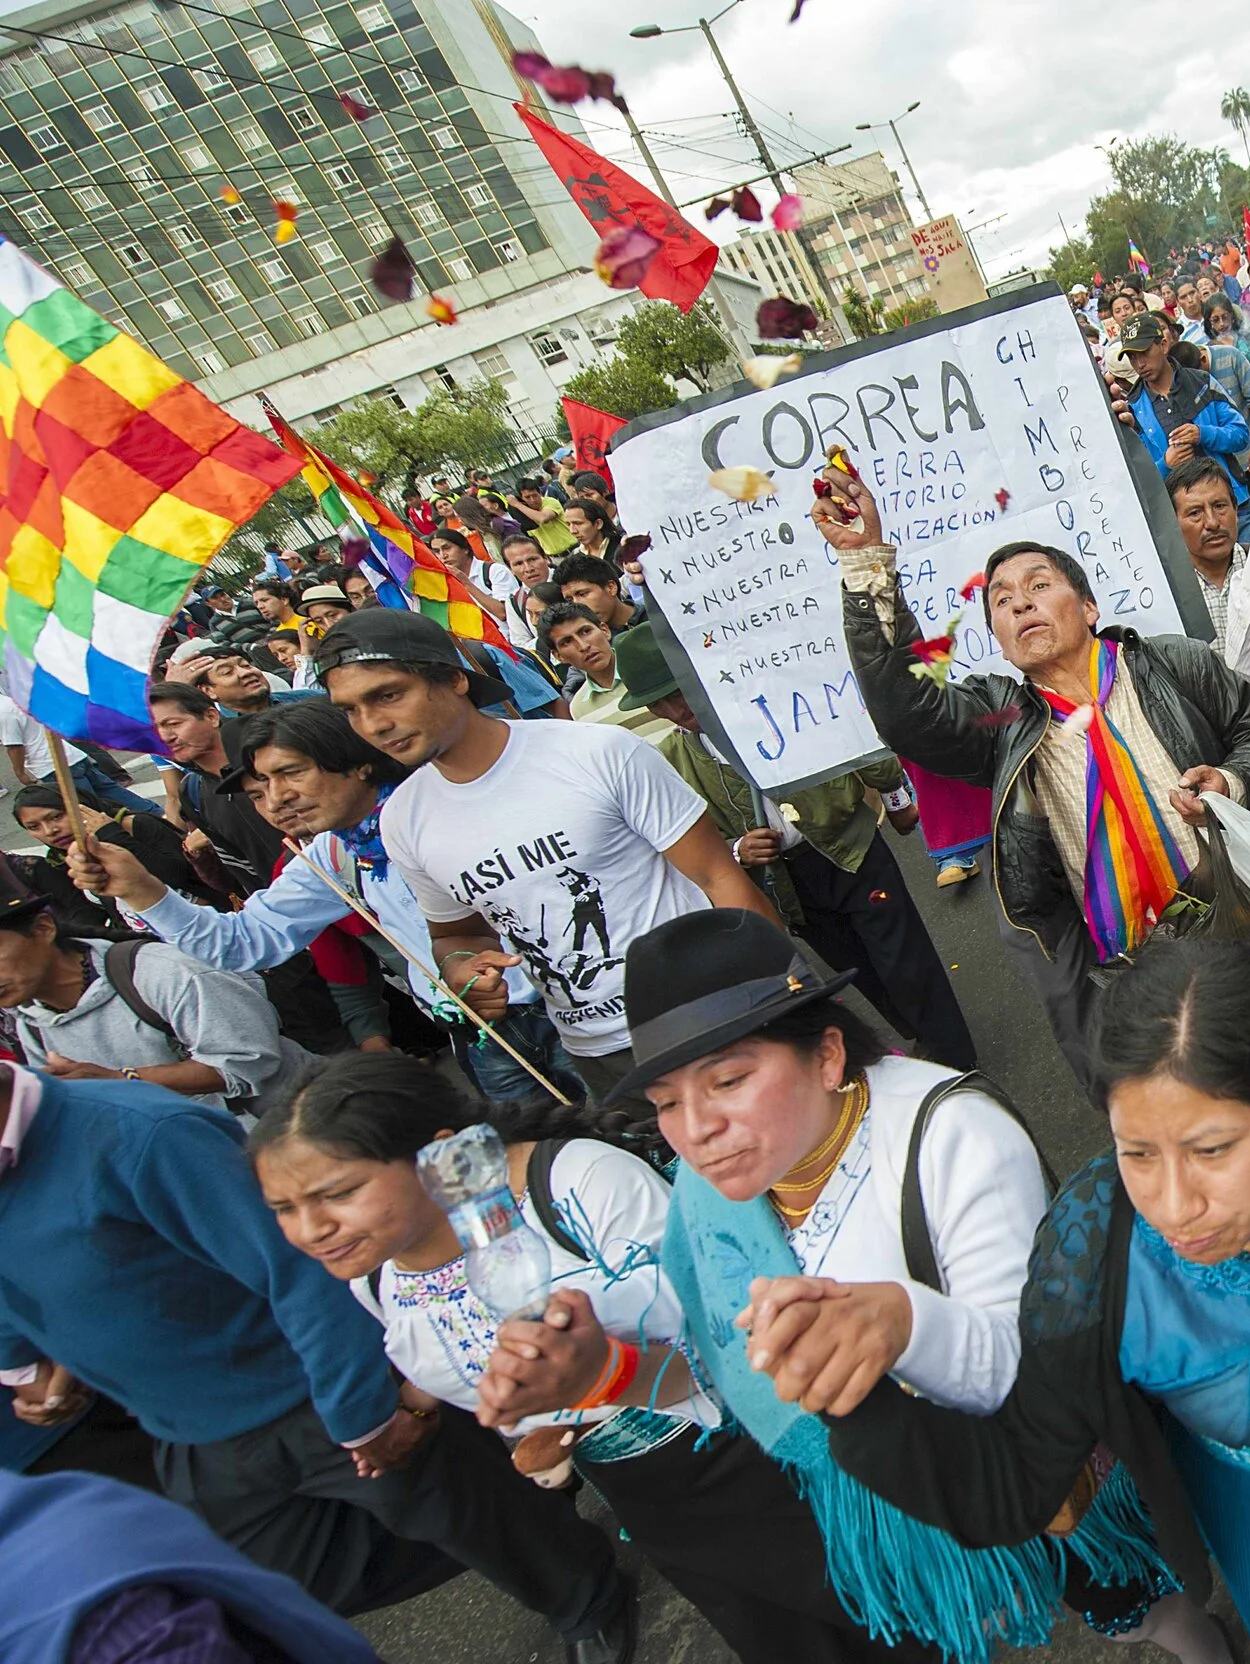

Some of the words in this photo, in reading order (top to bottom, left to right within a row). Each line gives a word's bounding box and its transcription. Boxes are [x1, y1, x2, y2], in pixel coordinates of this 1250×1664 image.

[911, 229, 930, 247] DE
[931, 220, 949, 234] AQUI
[937, 240, 963, 257] SACA
[701, 360, 986, 480] CORREA
[659, 493, 780, 545] NUESTRA
[682, 522, 795, 577] NUESTRO
[702, 558, 808, 612] NUESTRA
[720, 596, 821, 641] NUESTRA
[739, 636, 837, 679] NUESTRA
[750, 671, 867, 761] JAM
[516, 831, 577, 872] ME
